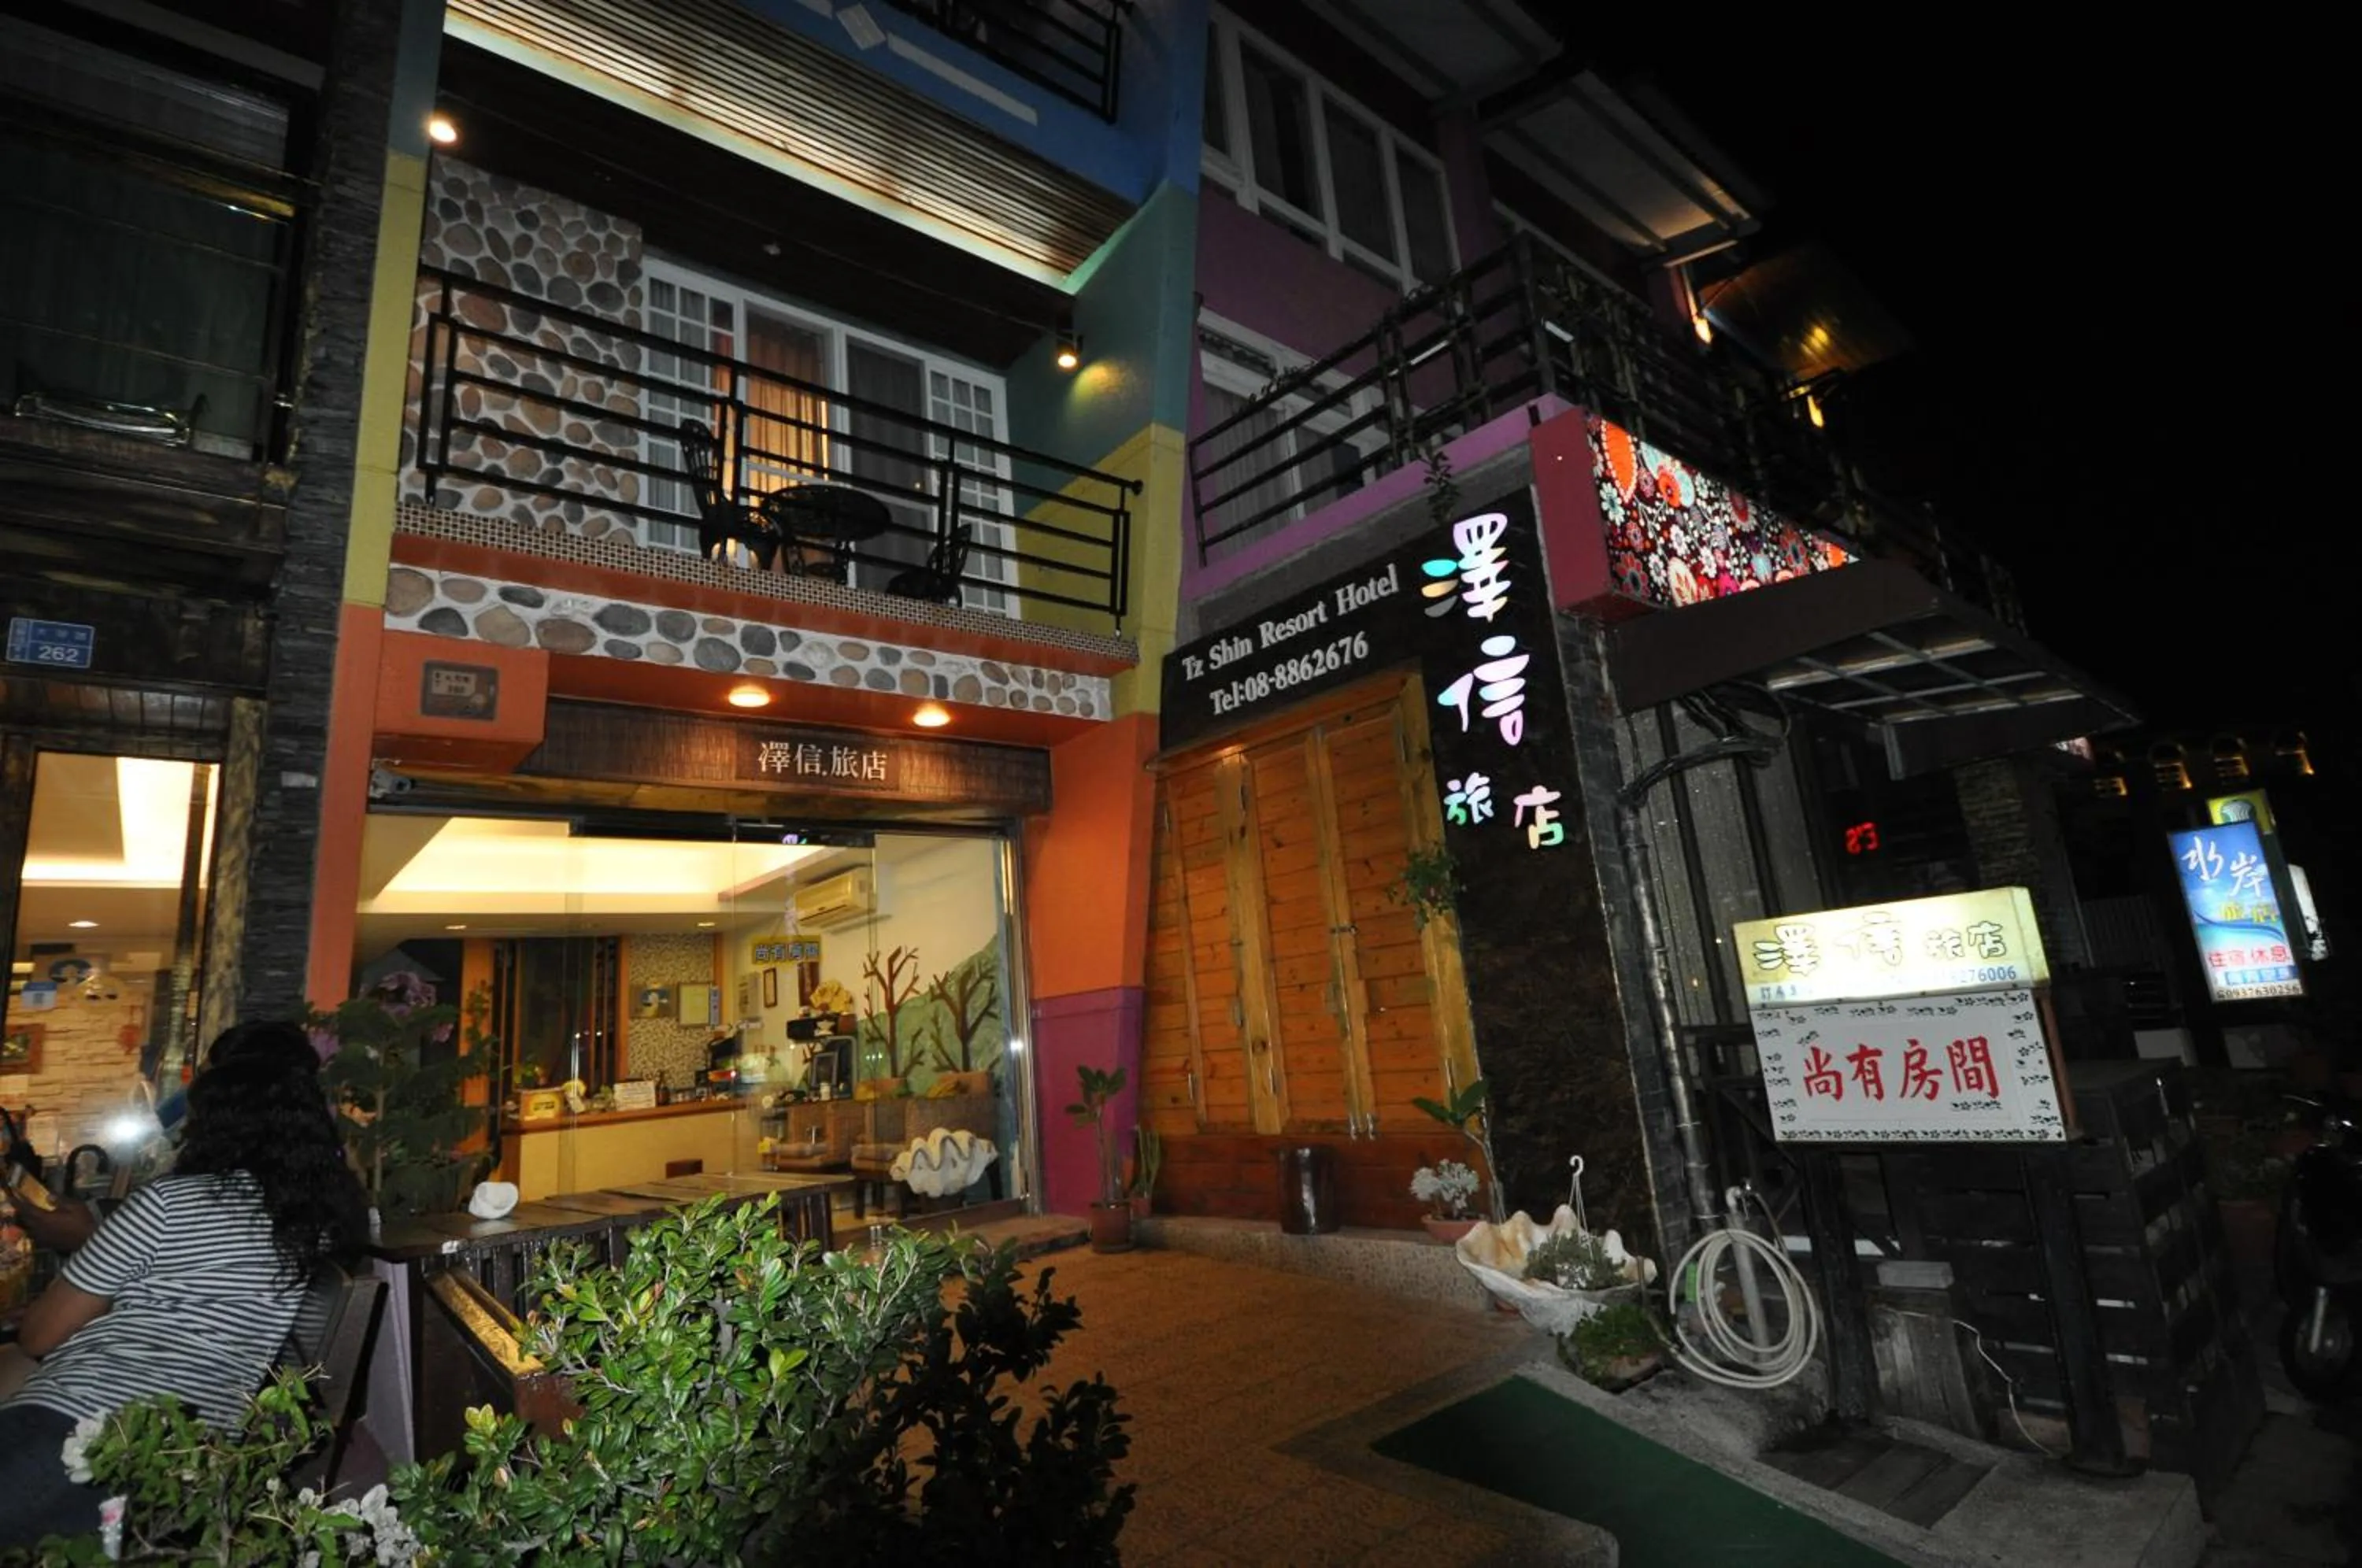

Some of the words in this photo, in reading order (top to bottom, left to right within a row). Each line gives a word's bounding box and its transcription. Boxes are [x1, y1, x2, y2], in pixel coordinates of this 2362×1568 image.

[37, 645, 79, 662] 262
[1182, 654, 1205, 681] Tz
[1209, 635, 1254, 670] Shin
[1258, 600, 1329, 649] Resort
[1335, 563, 1400, 616] Hotel
[1209, 631, 1370, 716] Tel:08-8862676
[1443, 771, 1564, 850] 旅店
[1802, 1035, 2001, 1102] 尚有房間
